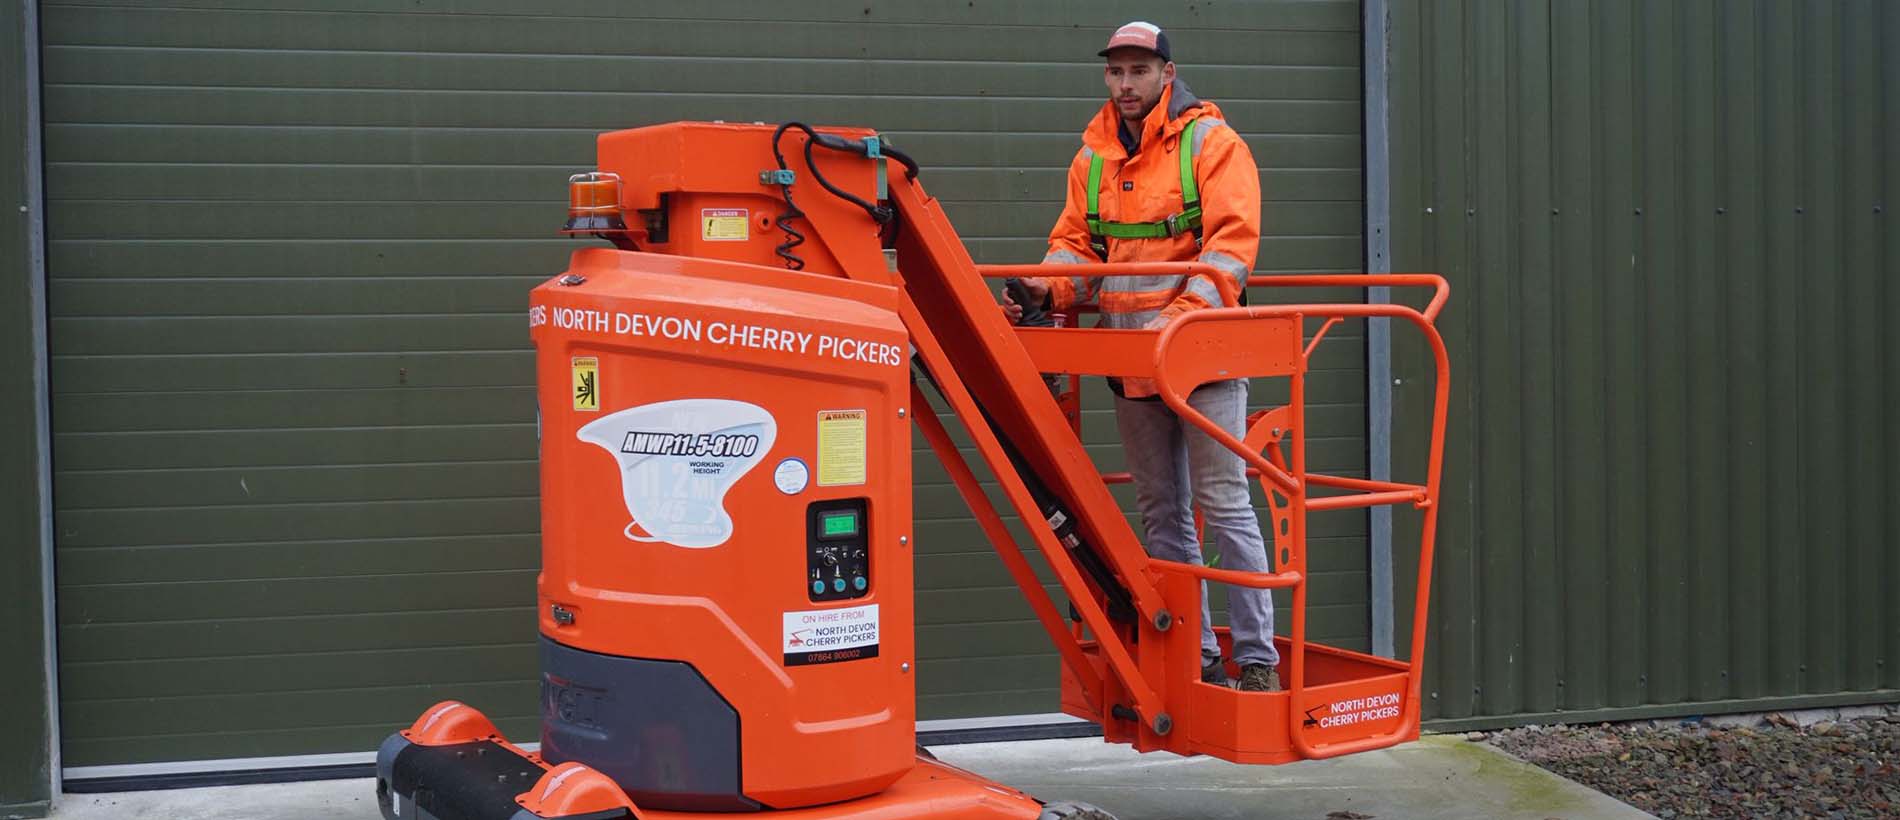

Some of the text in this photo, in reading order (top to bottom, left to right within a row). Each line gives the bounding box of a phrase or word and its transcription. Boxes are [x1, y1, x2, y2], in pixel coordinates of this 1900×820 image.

[553, 306, 901, 366] NORTH DEVON CHERRY PICKERS
[621, 431, 759, 457] AMWP11.5-8100
[802, 610, 865, 624] ON HIRE FROM
[806, 632, 876, 647] CHERRY PICKERS
[815, 622, 876, 636] NORTH DEVON
[1331, 693, 1400, 714] NORTH DEVON
[1320, 705, 1399, 728] CHERRY PICKERS
